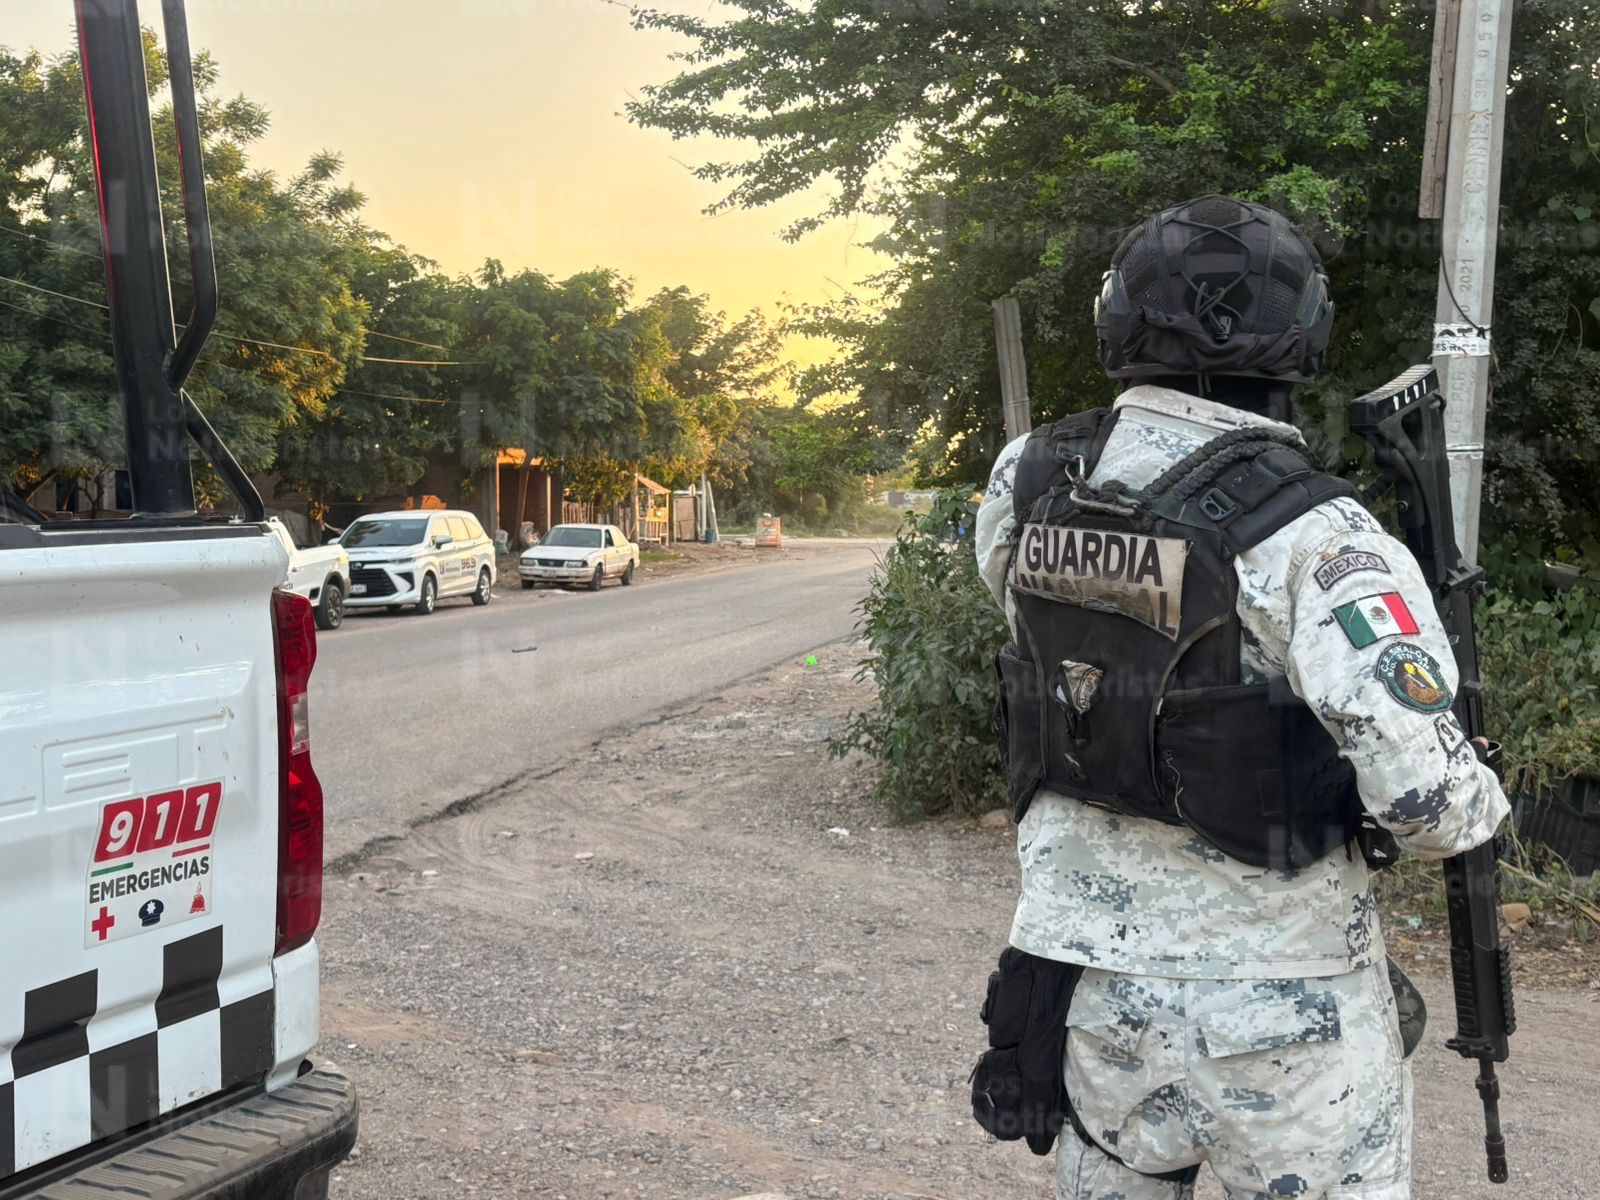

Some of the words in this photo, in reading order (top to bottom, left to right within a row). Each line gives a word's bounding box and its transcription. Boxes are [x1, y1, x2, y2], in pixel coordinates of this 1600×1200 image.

[1460, 259, 1474, 292] 2021
[1025, 526, 1163, 587] GUARDIA
[1322, 554, 1379, 583] MEXICO
[105, 792, 210, 853] 911
[89, 856, 210, 904] EMERGENCIAS
